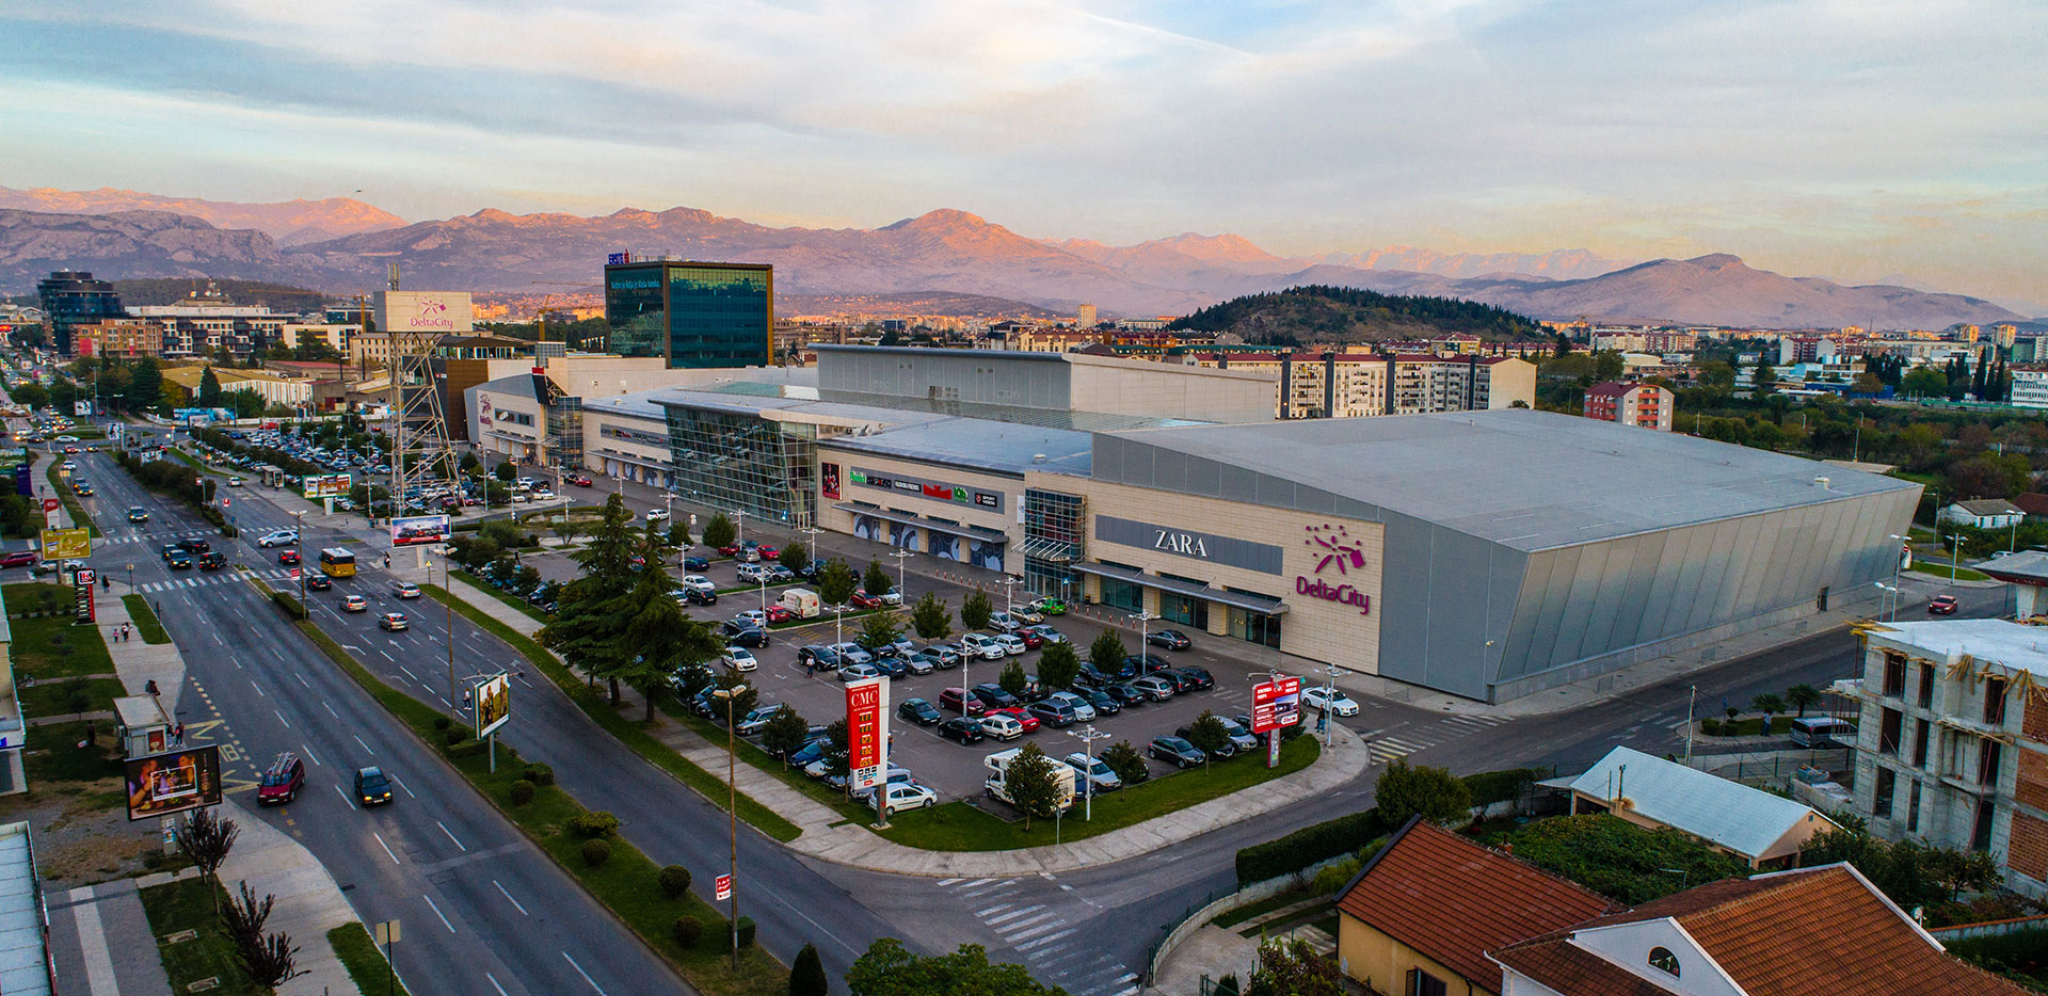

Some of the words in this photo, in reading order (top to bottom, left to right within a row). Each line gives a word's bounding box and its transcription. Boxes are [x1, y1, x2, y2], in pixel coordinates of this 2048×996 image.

[410, 317, 453, 329] DeltaCity
[1155, 529, 1208, 557] ZARA
[1296, 576, 1369, 615] DeltaCity
[851, 690, 878, 707] CMC
